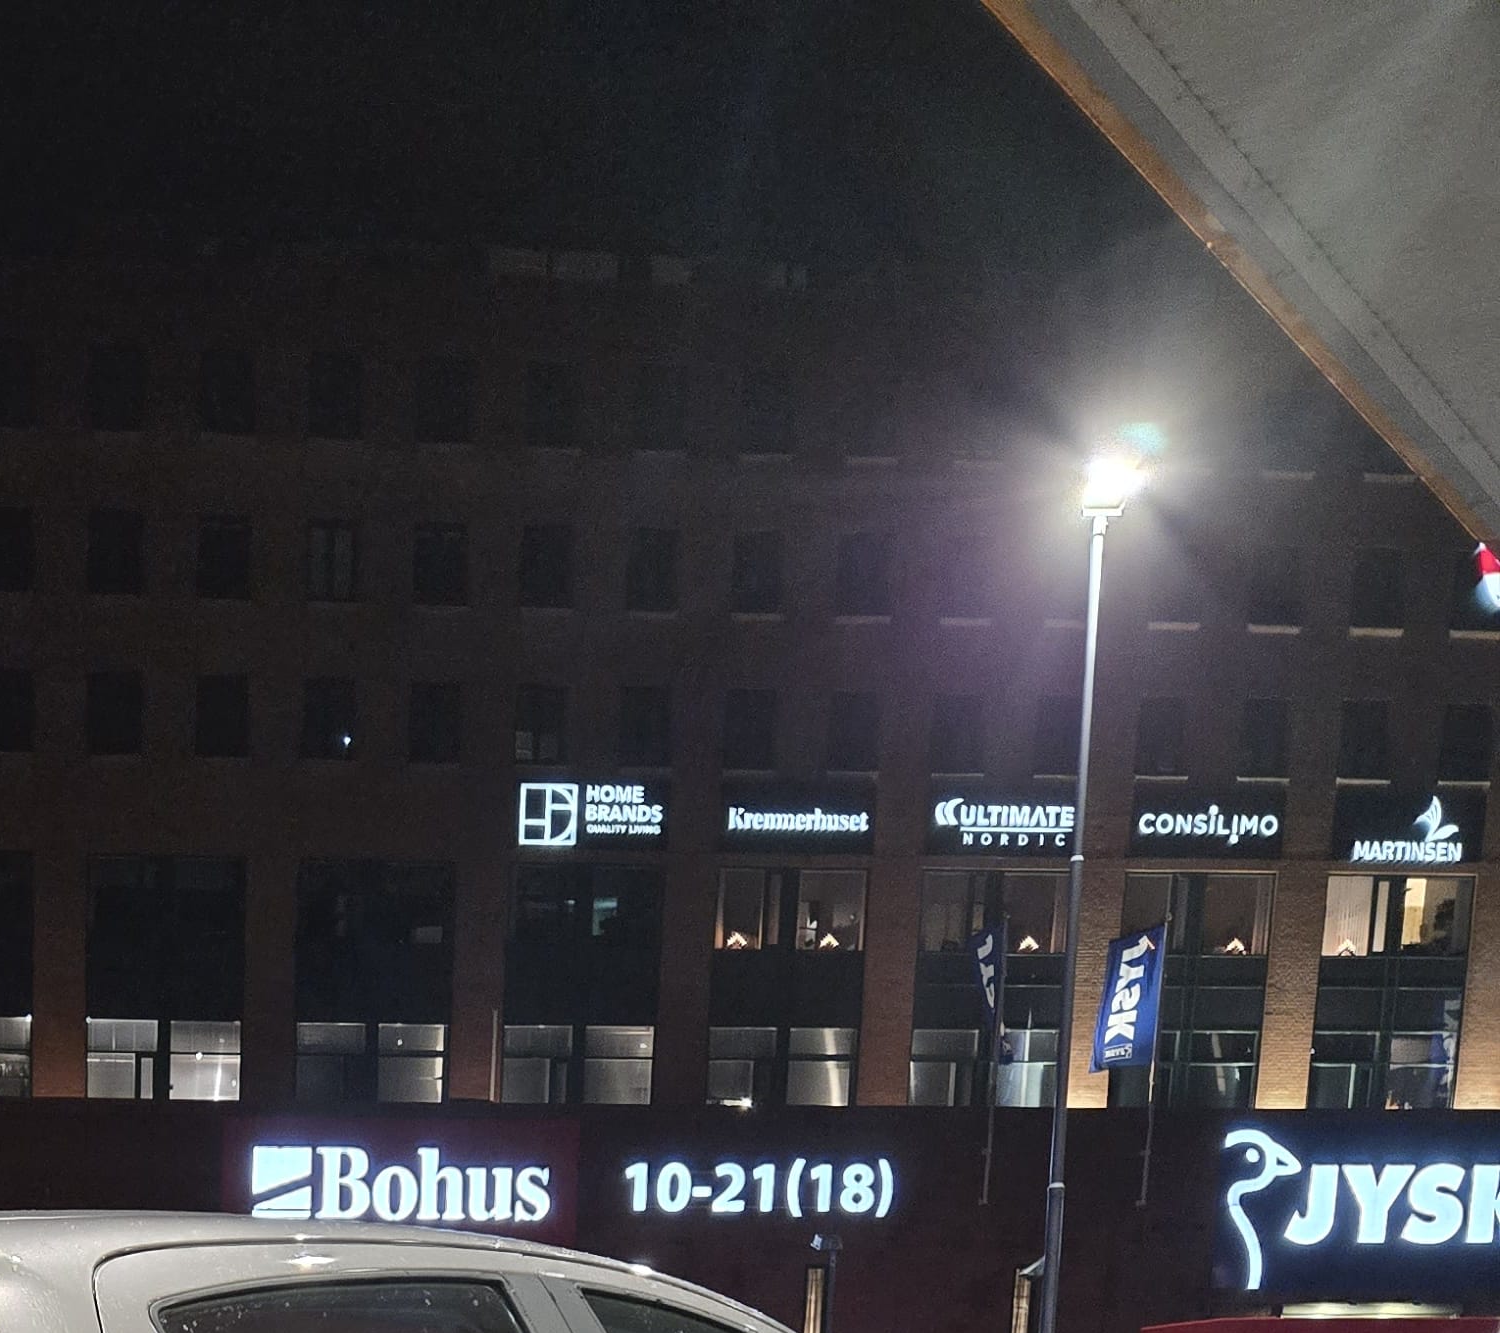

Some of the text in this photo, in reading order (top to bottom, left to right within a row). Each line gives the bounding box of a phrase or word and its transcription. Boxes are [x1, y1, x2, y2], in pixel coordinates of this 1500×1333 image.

[586, 784, 645, 803] HOME
[585, 804, 663, 823] BRANDS
[961, 804, 1075, 828] ULTIMATE
[586, 823, 627, 834] QUALITY
[628, 824, 661, 835] LIVING
[963, 832, 1067, 846] NORDIC
[1351, 840, 1463, 864] MARTINSEN
[317, 1146, 551, 1222] Bohus
[624, 1158, 894, 1219] 10-21(18)
